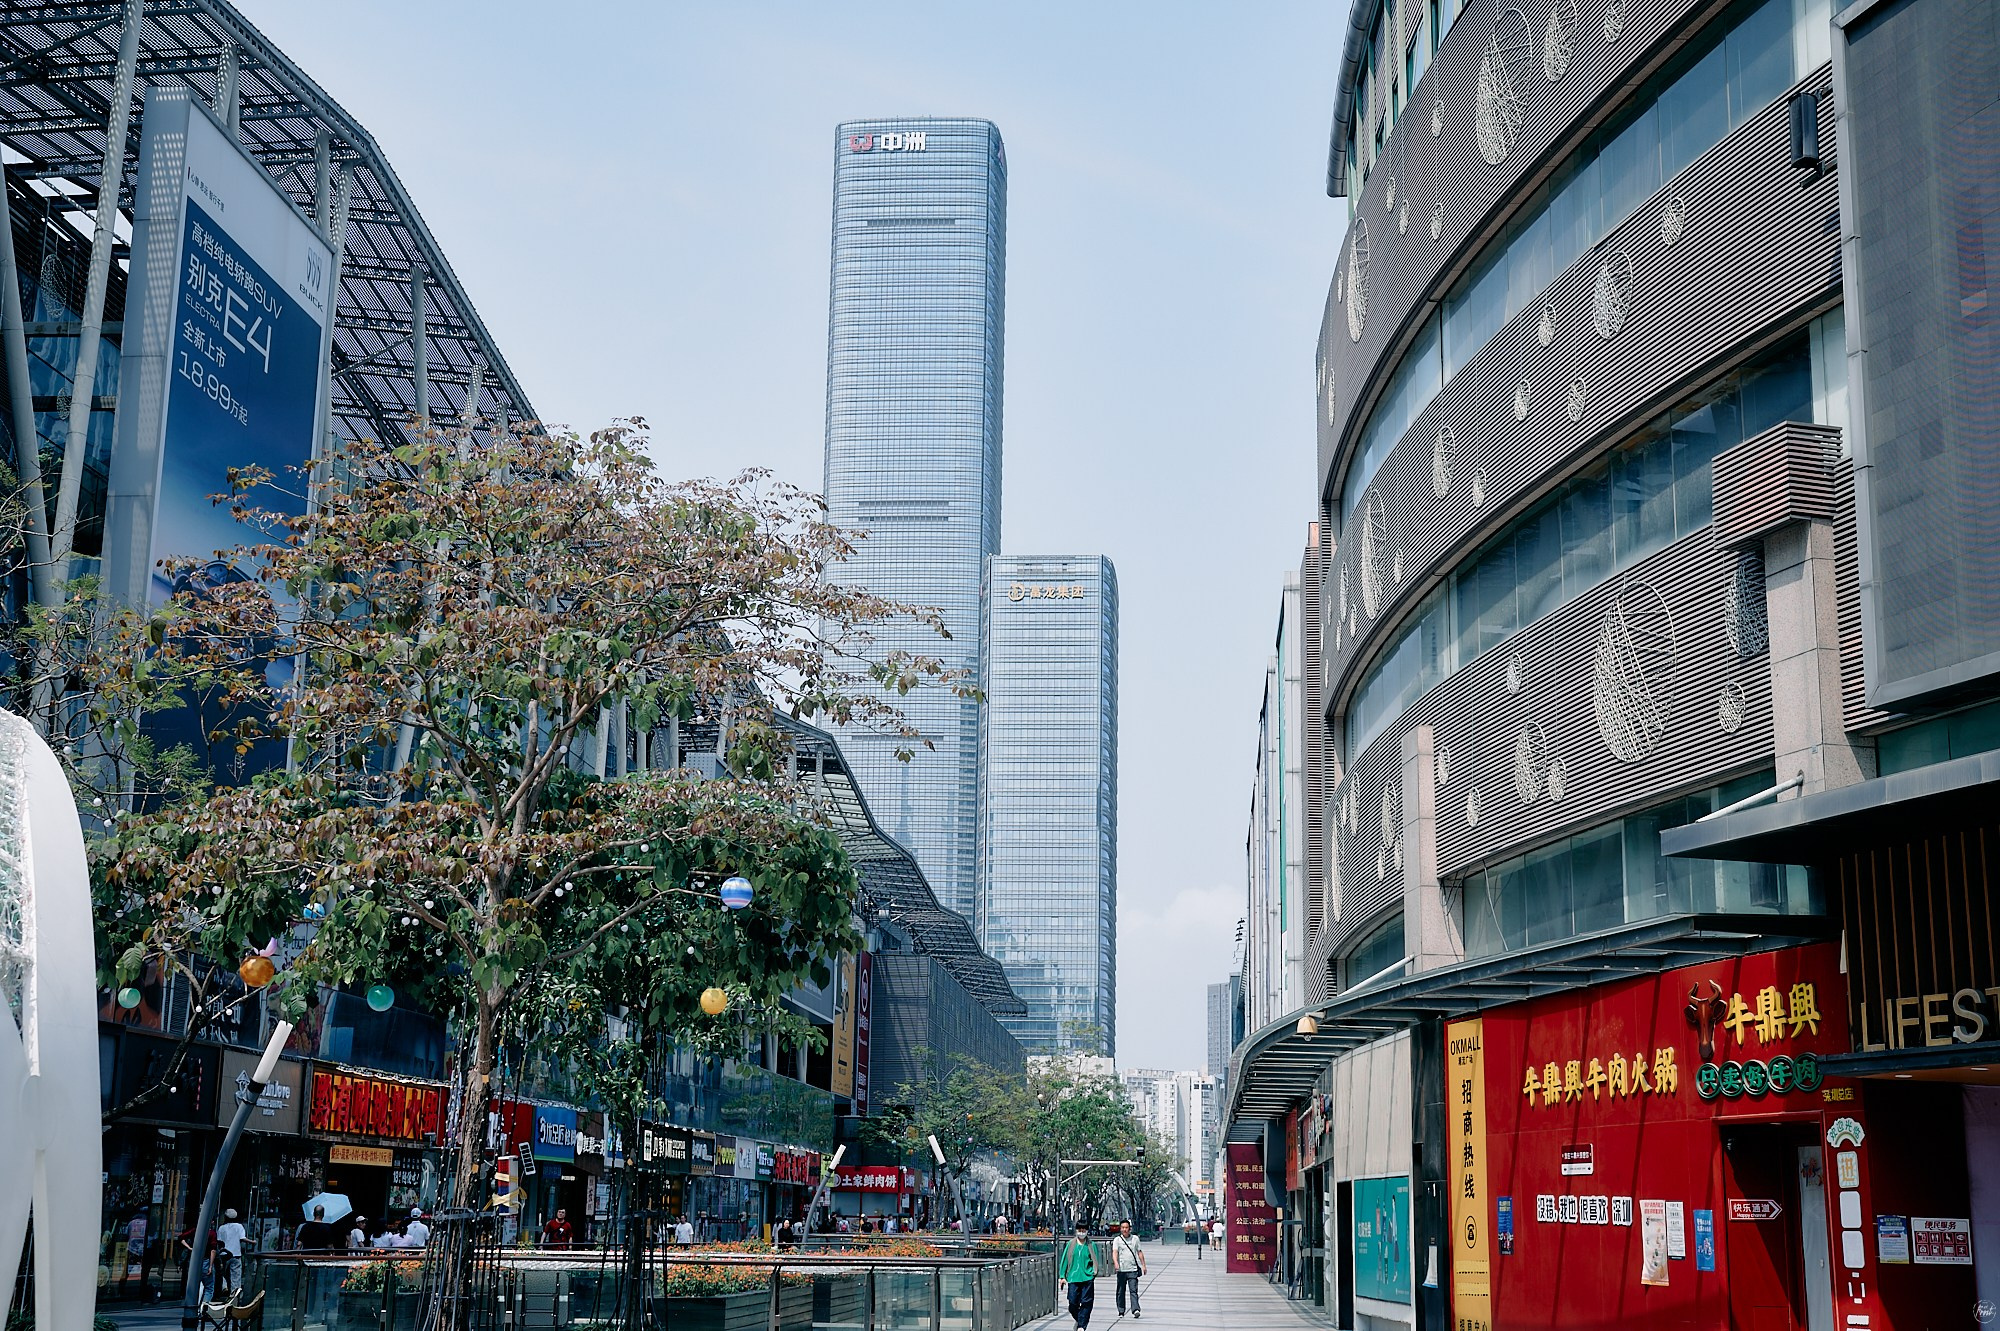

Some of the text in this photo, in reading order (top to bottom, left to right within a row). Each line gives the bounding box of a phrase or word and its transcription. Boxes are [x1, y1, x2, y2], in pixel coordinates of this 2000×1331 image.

[880, 131, 926, 151] 中洲
[299, 283, 324, 313] BUICK
[185, 293, 221, 332] ELECTRA
[186, 253, 272, 374] 别克 E4
[183, 319, 227, 368] 全新上市
[1450, 1036, 1481, 1056] OKMALL
[1700, 1060, 1818, 1092] 只卖好牛肉
[1822, 1087, 1854, 1102] 深圳总店
[1461, 1079, 1475, 1200] 招商热线
[1829, 1120, 1861, 1140] 欢迎光临
[841, 1173, 897, 1188] 土家鲜肉饼
[1236, 1200, 1266, 1208] 自由、平等
[1733, 1203, 1770, 1213] 快乐通道
[1236, 1217, 1266, 1226] 公正、法治
[1924, 1220, 1957, 1231] 便民服务
[1236, 1235, 1266, 1244] 爱国、敬业
[1236, 1253, 1266, 1261] 诚信、友善
